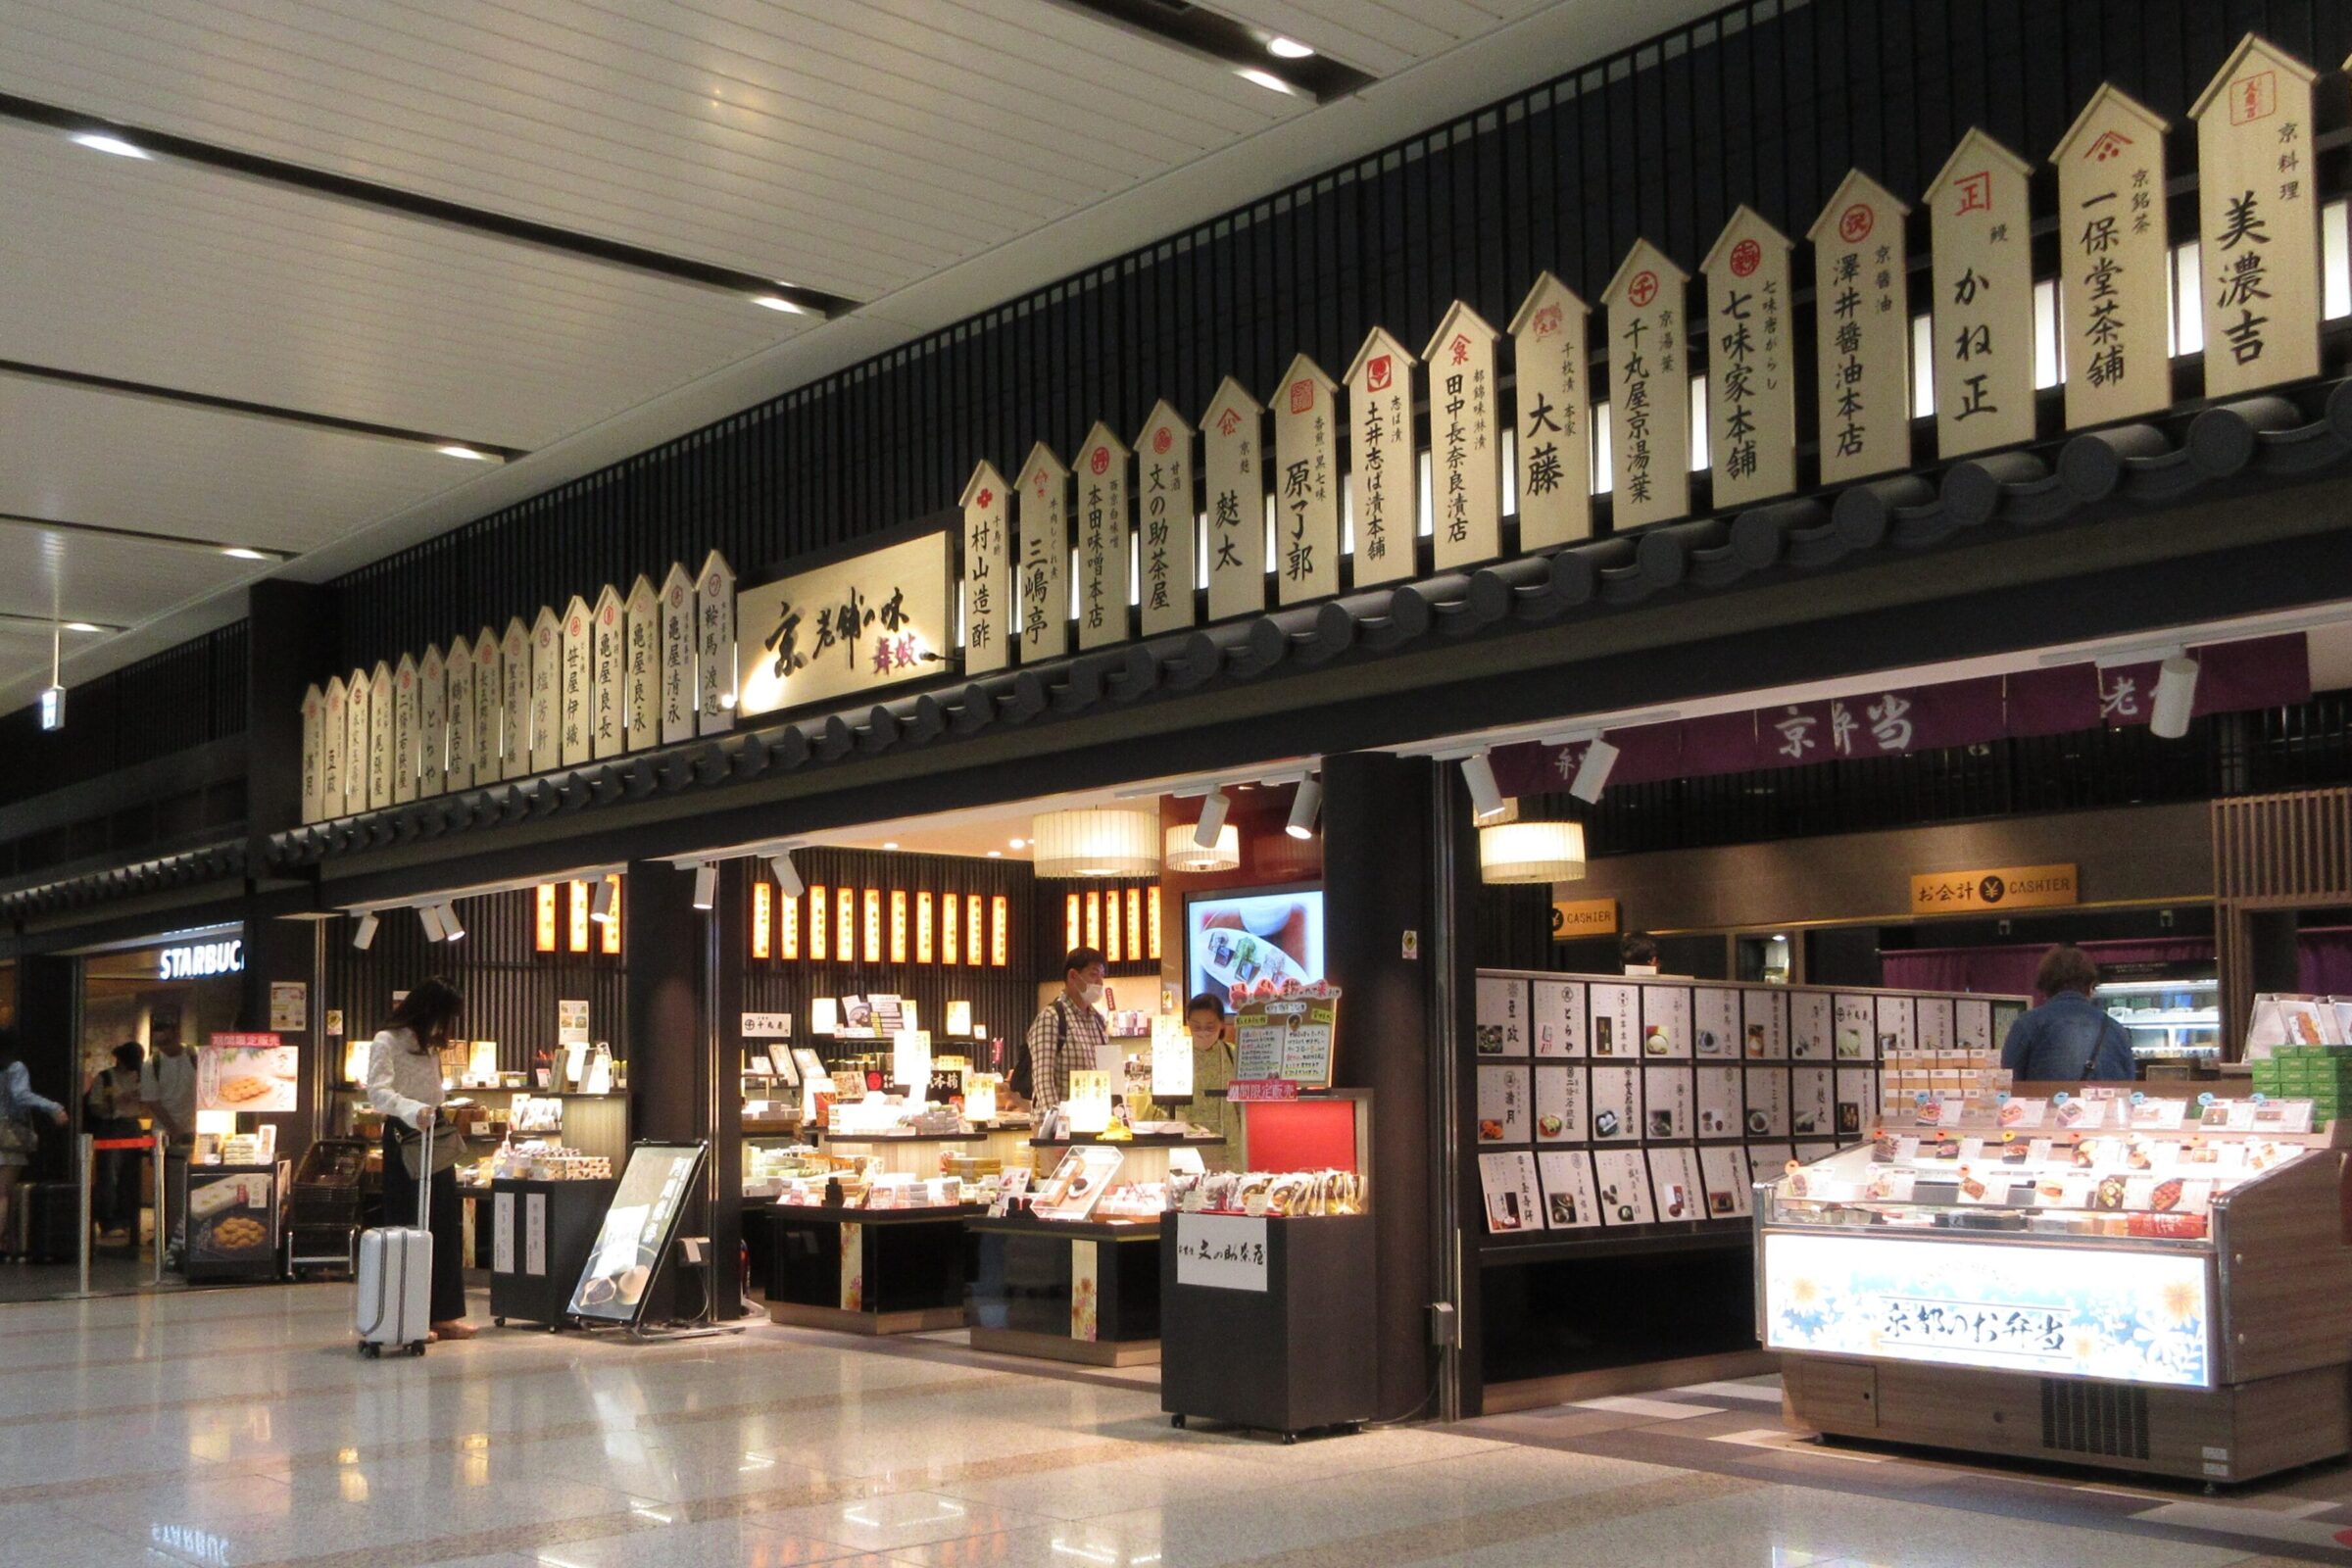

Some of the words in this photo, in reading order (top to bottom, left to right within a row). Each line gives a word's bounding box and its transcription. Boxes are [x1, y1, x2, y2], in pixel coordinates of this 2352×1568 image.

[2132, 169, 2151, 235] 京銘茶
[2278, 122, 2300, 201] 京料理
[1763, 280, 1778, 391] 七味唐がらし
[2081, 191, 2125, 387] 一保堂茶舗
[2217, 190, 2272, 366] 美濃吉
[1659, 310, 1674, 374] 京湯葉
[1721, 290, 1756, 479] 七味家本舗
[1953, 268, 1997, 422] かね正
[1446, 373, 1469, 543] 田中長奈良漬店
[1526, 393, 1565, 497] 大藤
[1623, 318, 1652, 505] 千丸屋京湯葉
[1149, 464, 1169, 610] 文の助茶屋
[1285, 459, 1313, 581] 原了郭
[1365, 401, 1386, 561] 土井志ば漬本舗
[972, 521, 991, 649] 村山造酢
[1025, 539, 1048, 645] 三嶋亭
[1088, 484, 1104, 628] 本田味噌本店
[1775, 694, 1912, 759] 京弁当
[1567, 910, 1611, 924] CASHIER
[1919, 880, 1974, 903] お会計
[2010, 878, 2071, 895] CASHIER
[160, 939, 244, 980] STARBUC
[1884, 1301, 2065, 1350] 京都のお弁当
